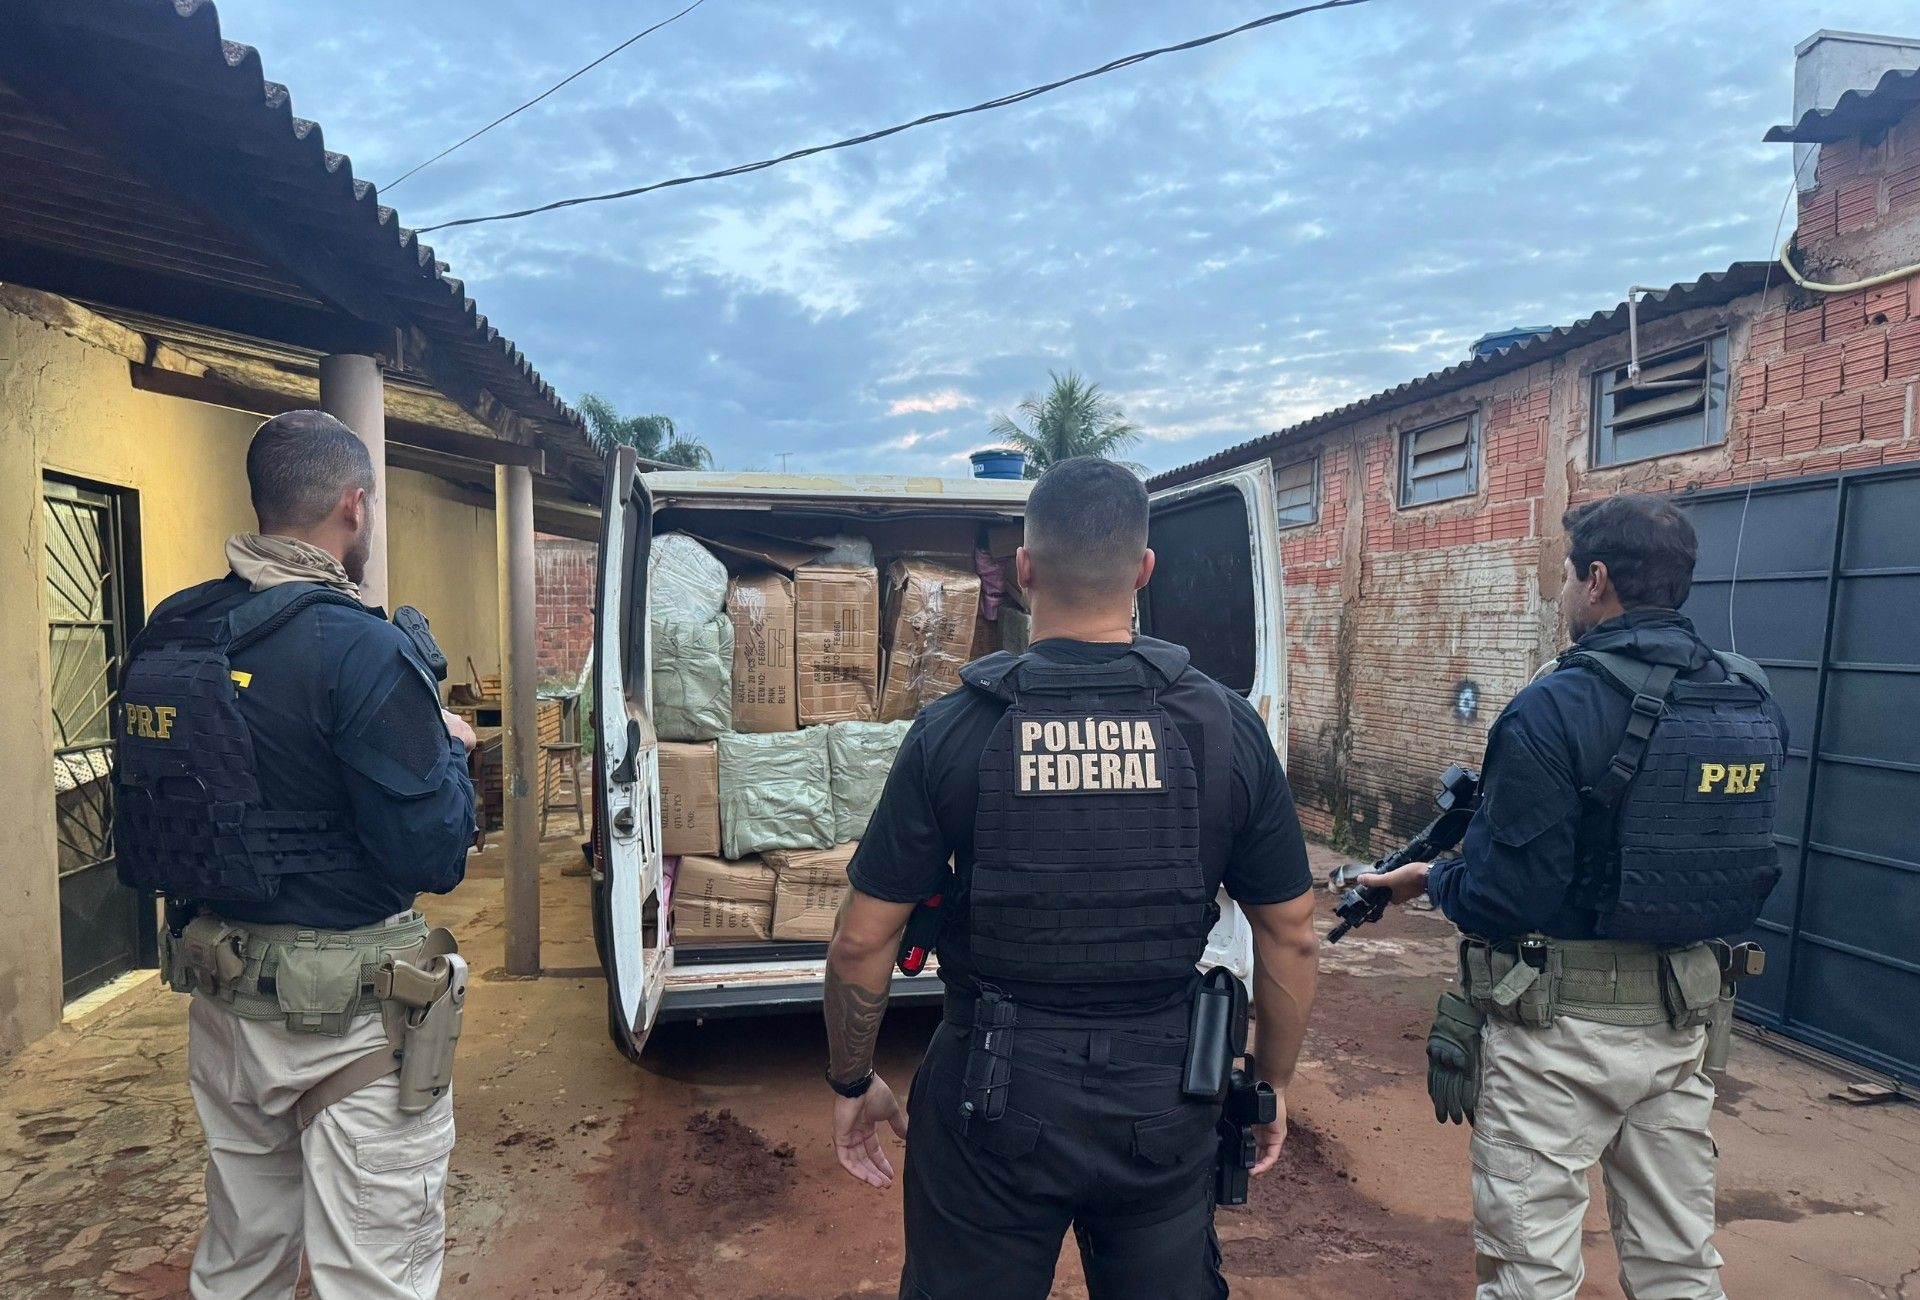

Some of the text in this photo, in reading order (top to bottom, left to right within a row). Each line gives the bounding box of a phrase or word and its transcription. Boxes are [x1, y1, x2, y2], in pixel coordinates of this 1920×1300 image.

[823, 638, 832, 654] PCS
[748, 658, 757, 673] PCS
[758, 640, 767, 704] ITEM NO: FE6060
[748, 675, 757, 684] 20
[748, 686, 757, 704] QTY:
[768, 687, 777, 704] PINK
[778, 685, 787, 704] BLUE
[125, 703, 176, 739] PRF
[1021, 717, 1156, 751] POLÍCIA
[1020, 753, 1162, 791] FEDERAL
[1697, 763, 1765, 794] PRF
